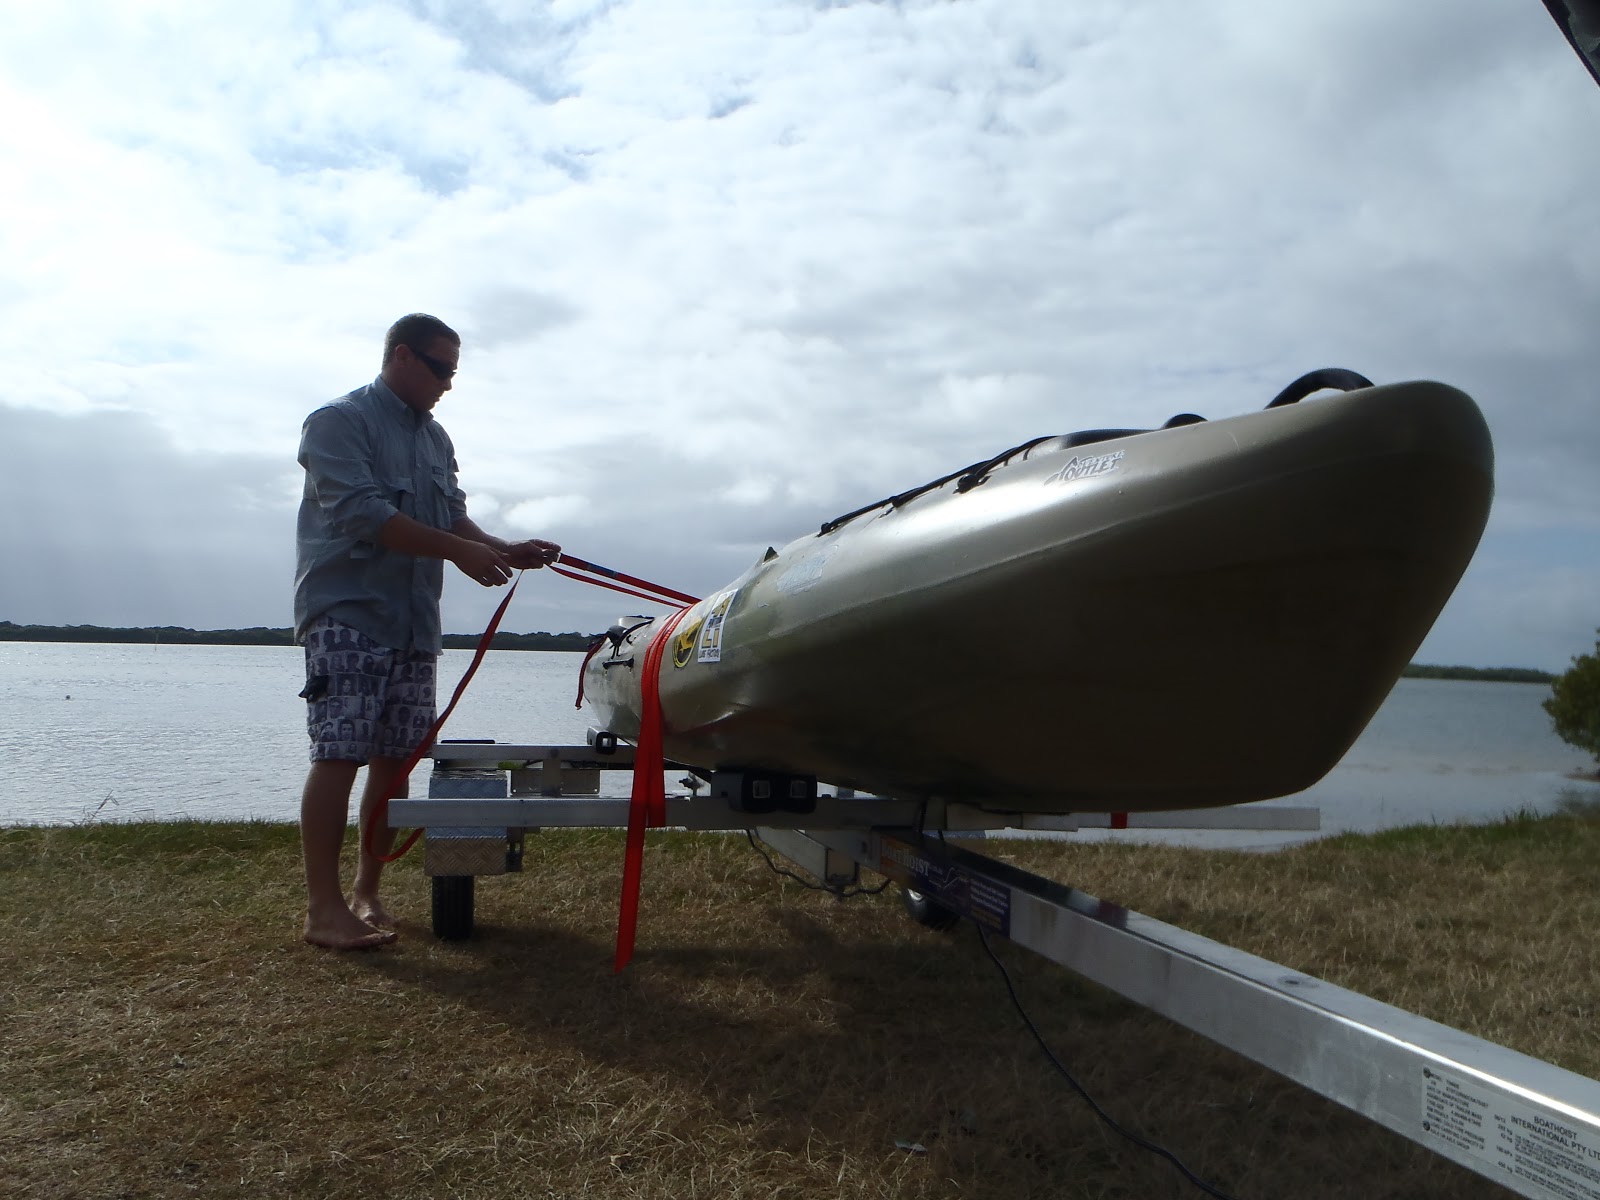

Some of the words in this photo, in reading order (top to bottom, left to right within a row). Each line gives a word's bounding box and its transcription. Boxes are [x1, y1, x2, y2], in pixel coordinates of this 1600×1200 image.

[1063, 458, 1122, 482] OUTLET
[1511, 1116, 1570, 1147] INTERNATIONAL
[1571, 1141, 1587, 1153] PTY
[1534, 1115, 1578, 1140] BOATHOIST
